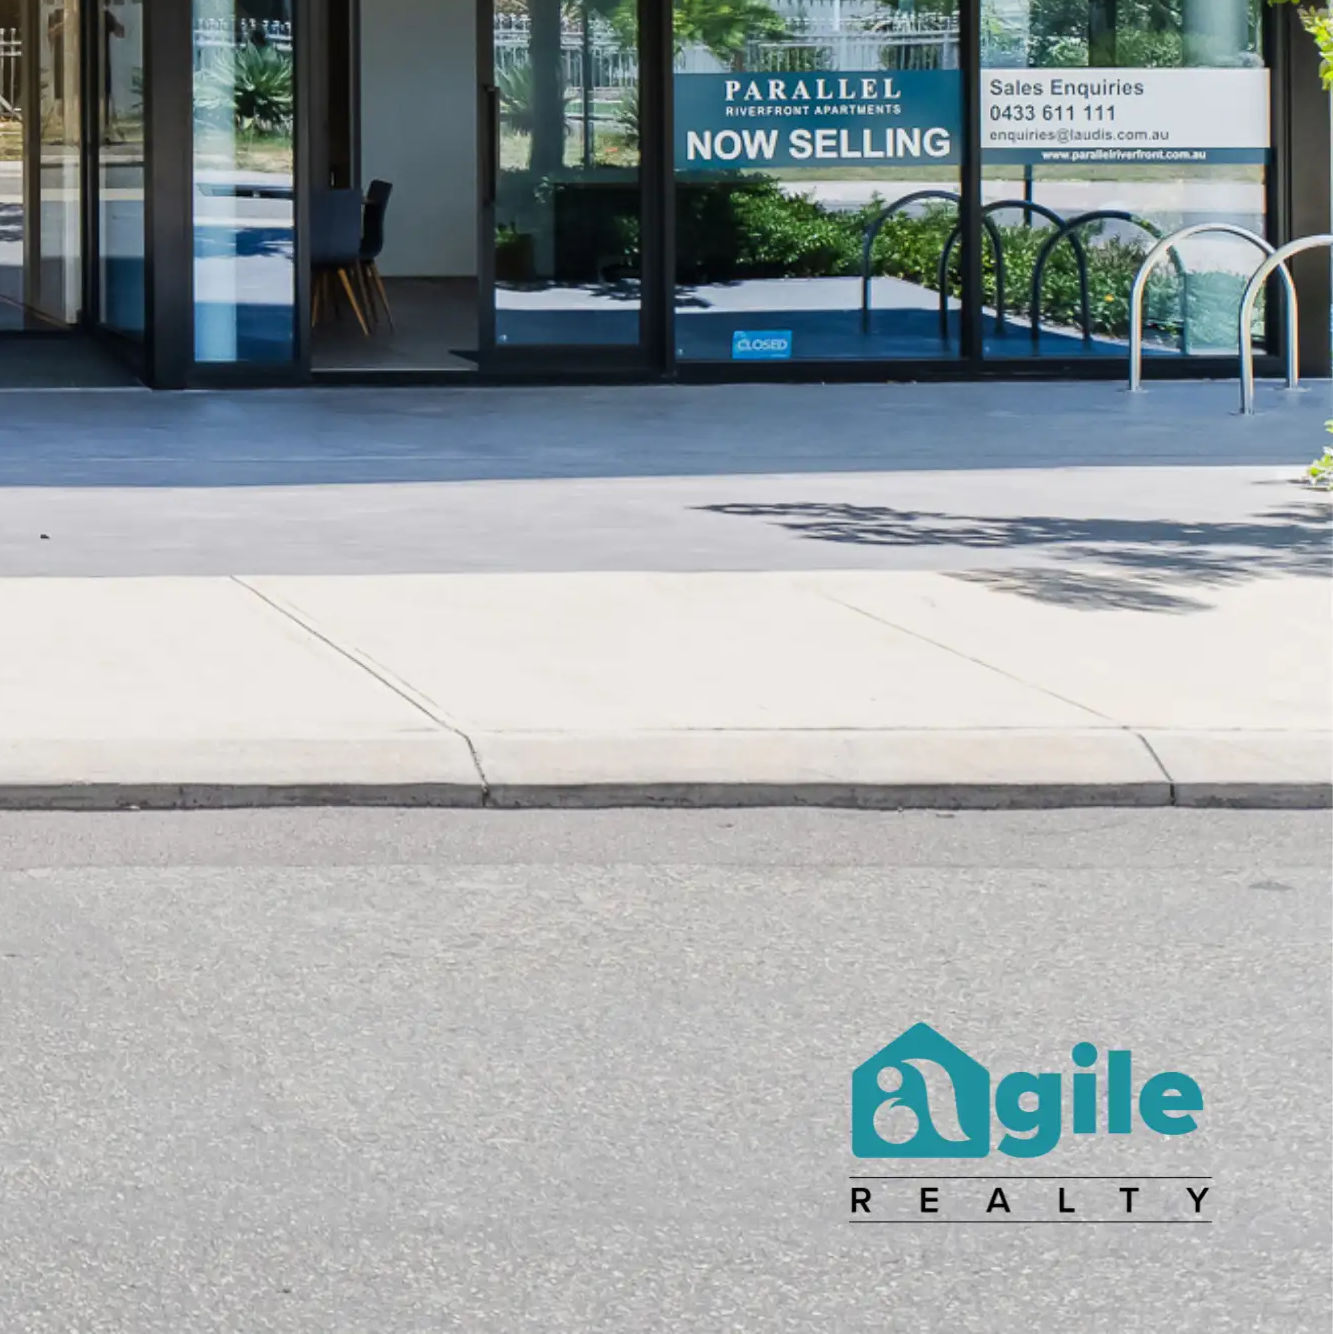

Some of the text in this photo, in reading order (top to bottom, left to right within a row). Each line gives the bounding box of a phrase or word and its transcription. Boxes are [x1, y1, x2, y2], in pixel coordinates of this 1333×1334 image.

[725, 78, 901, 102] PARALLEL
[989, 78, 1144, 100] Sales Enquiries
[725, 104, 902, 117] RIVERFRONT APARTMENTS
[989, 104, 1116, 121] 0433 611 111
[687, 127, 951, 160] NOW SELLING
[989, 129, 1170, 144] enquiries@laudis.com.au
[1041, 149, 1207, 162] www.parallelriverfront.com.au
[737, 339, 788, 351] CLOSED
